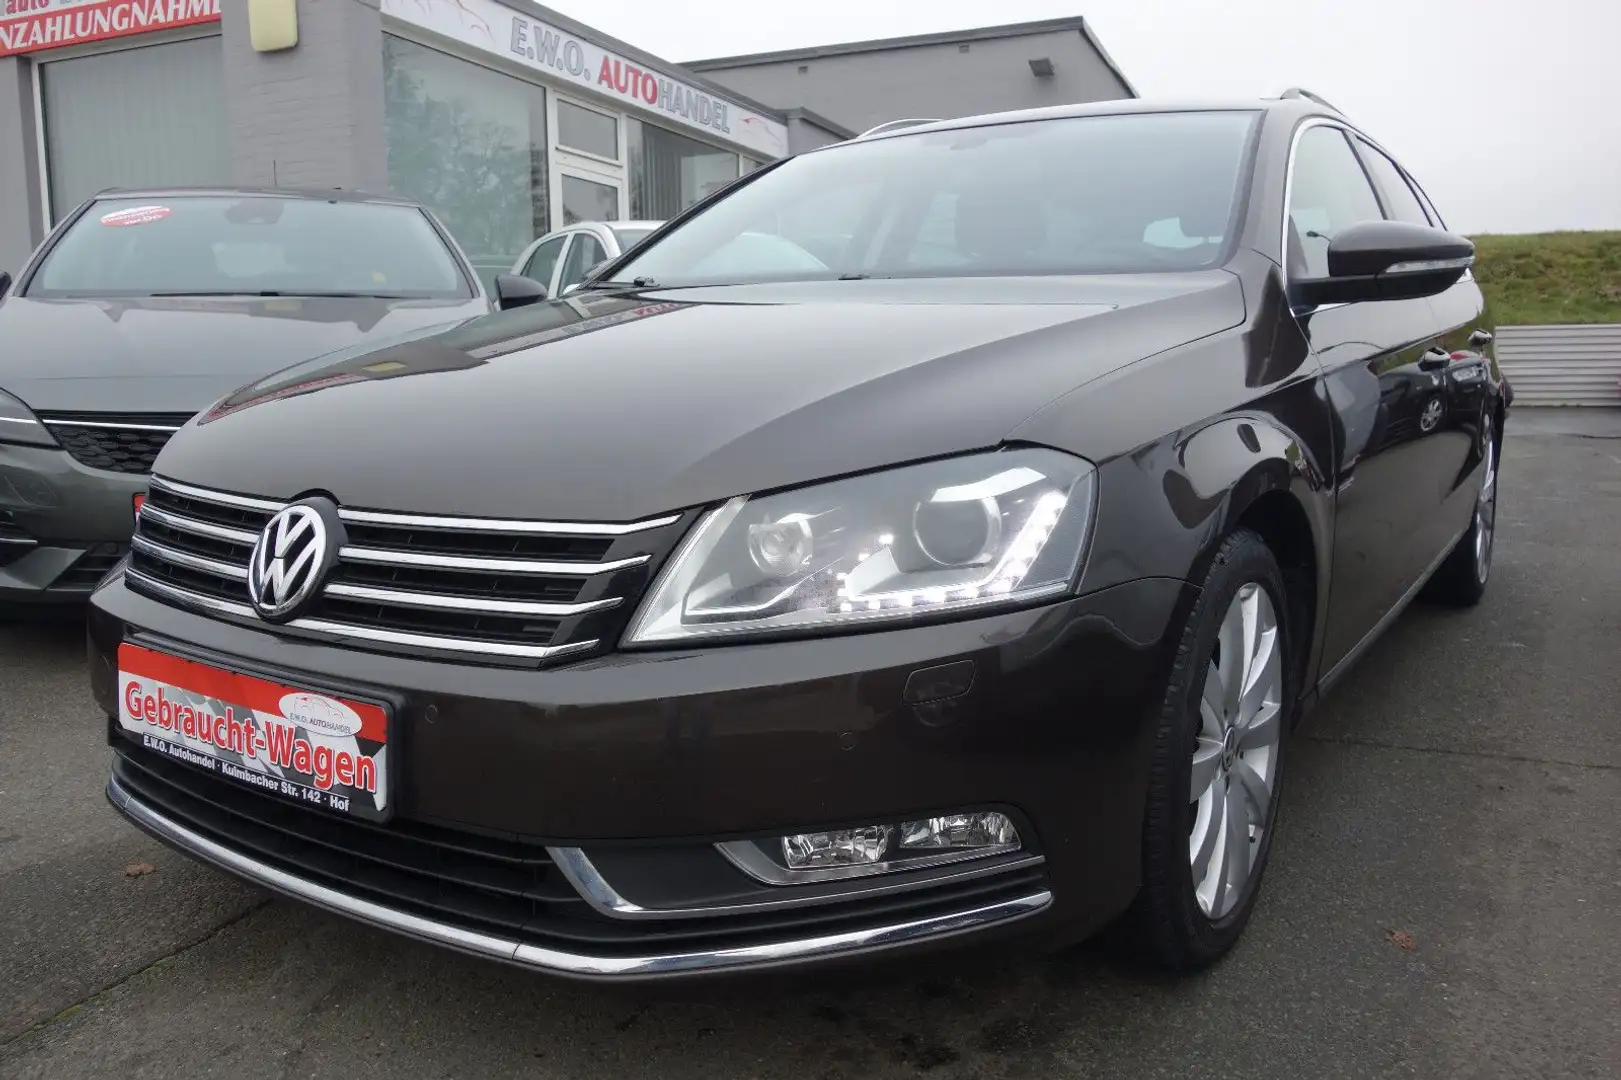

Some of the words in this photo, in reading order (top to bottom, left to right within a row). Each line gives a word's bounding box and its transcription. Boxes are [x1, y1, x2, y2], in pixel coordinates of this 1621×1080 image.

[510, 16, 591, 81] E.W.O.
[597, 55, 731, 134] AUTOHANDEL
[125, 680, 378, 795] Gebraucht-Wagen
[143, 734, 167, 753] E.W.O.
[169, 743, 215, 770] Autohandel
[221, 761, 279, 791] Kulmbacher
[281, 781, 299, 797] Str.
[301, 787, 321, 804] 142
[329, 795, 350, 812] Hof
[309, 717, 352, 735] AUTOHANDEL
